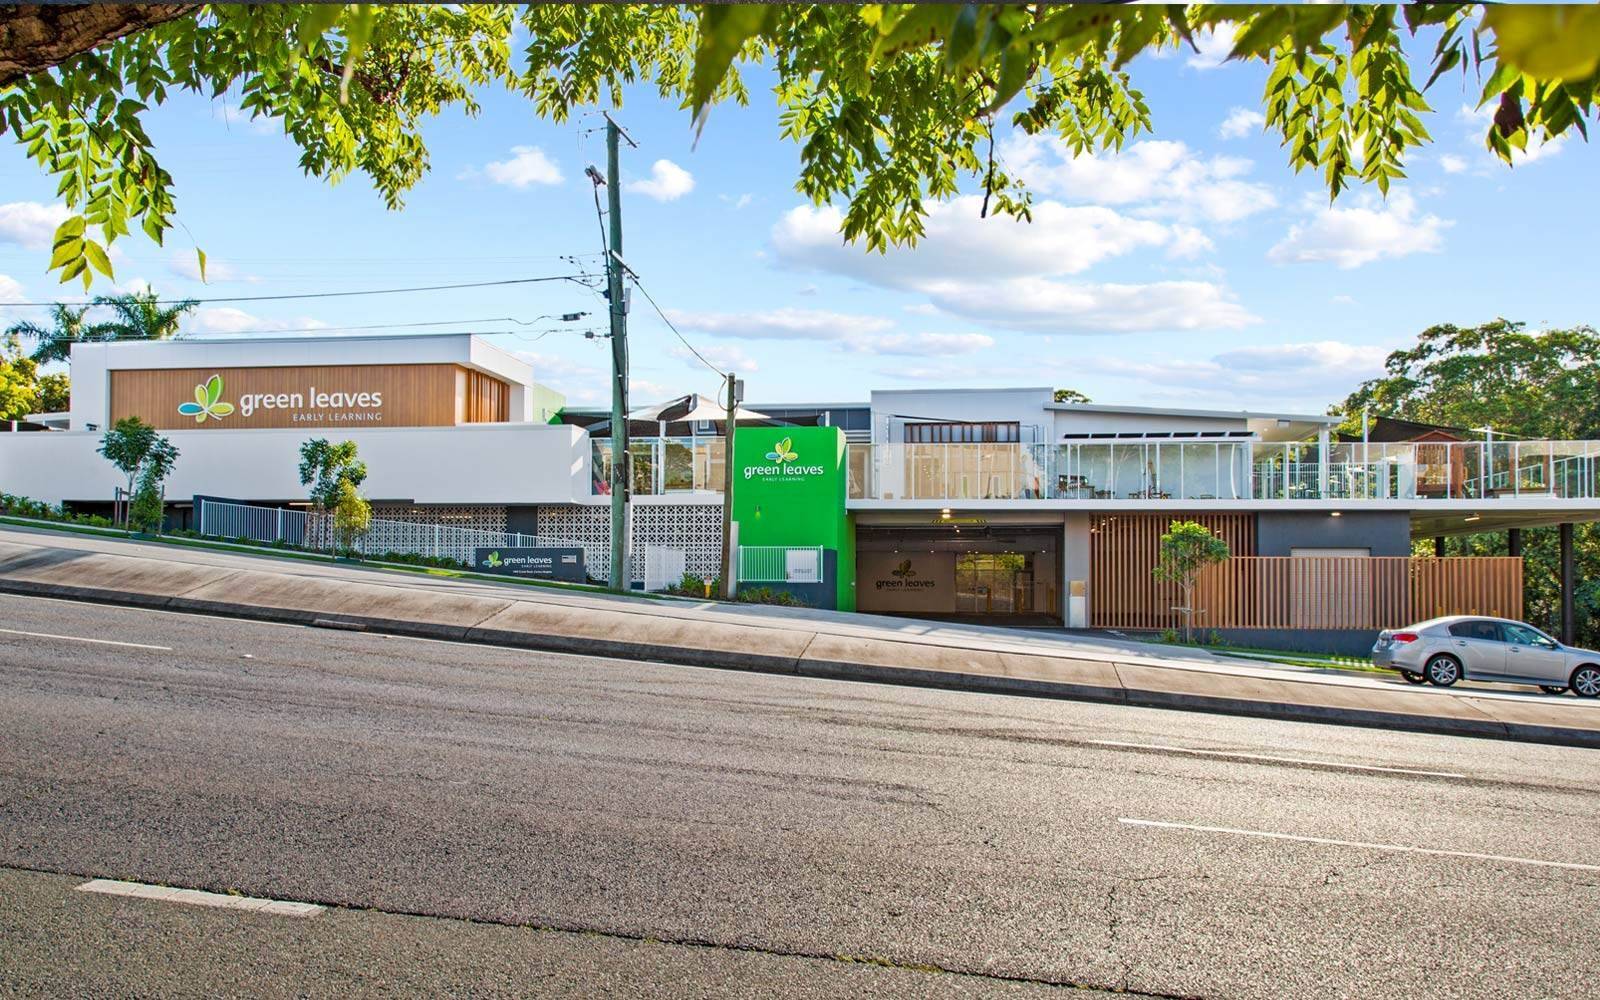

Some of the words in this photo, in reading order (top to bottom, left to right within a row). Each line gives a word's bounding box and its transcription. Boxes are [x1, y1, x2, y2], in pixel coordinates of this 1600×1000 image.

[240, 393, 303, 416] green
[310, 387, 382, 408] leaves
[292, 413, 324, 422] EARLY
[328, 412, 382, 421] LEARNING
[743, 466, 780, 480] green
[783, 463, 824, 475] leaves
[503, 558, 525, 566] green
[527, 556, 552, 564] leaves
[875, 580, 903, 590] green
[904, 578, 936, 588] leaves
